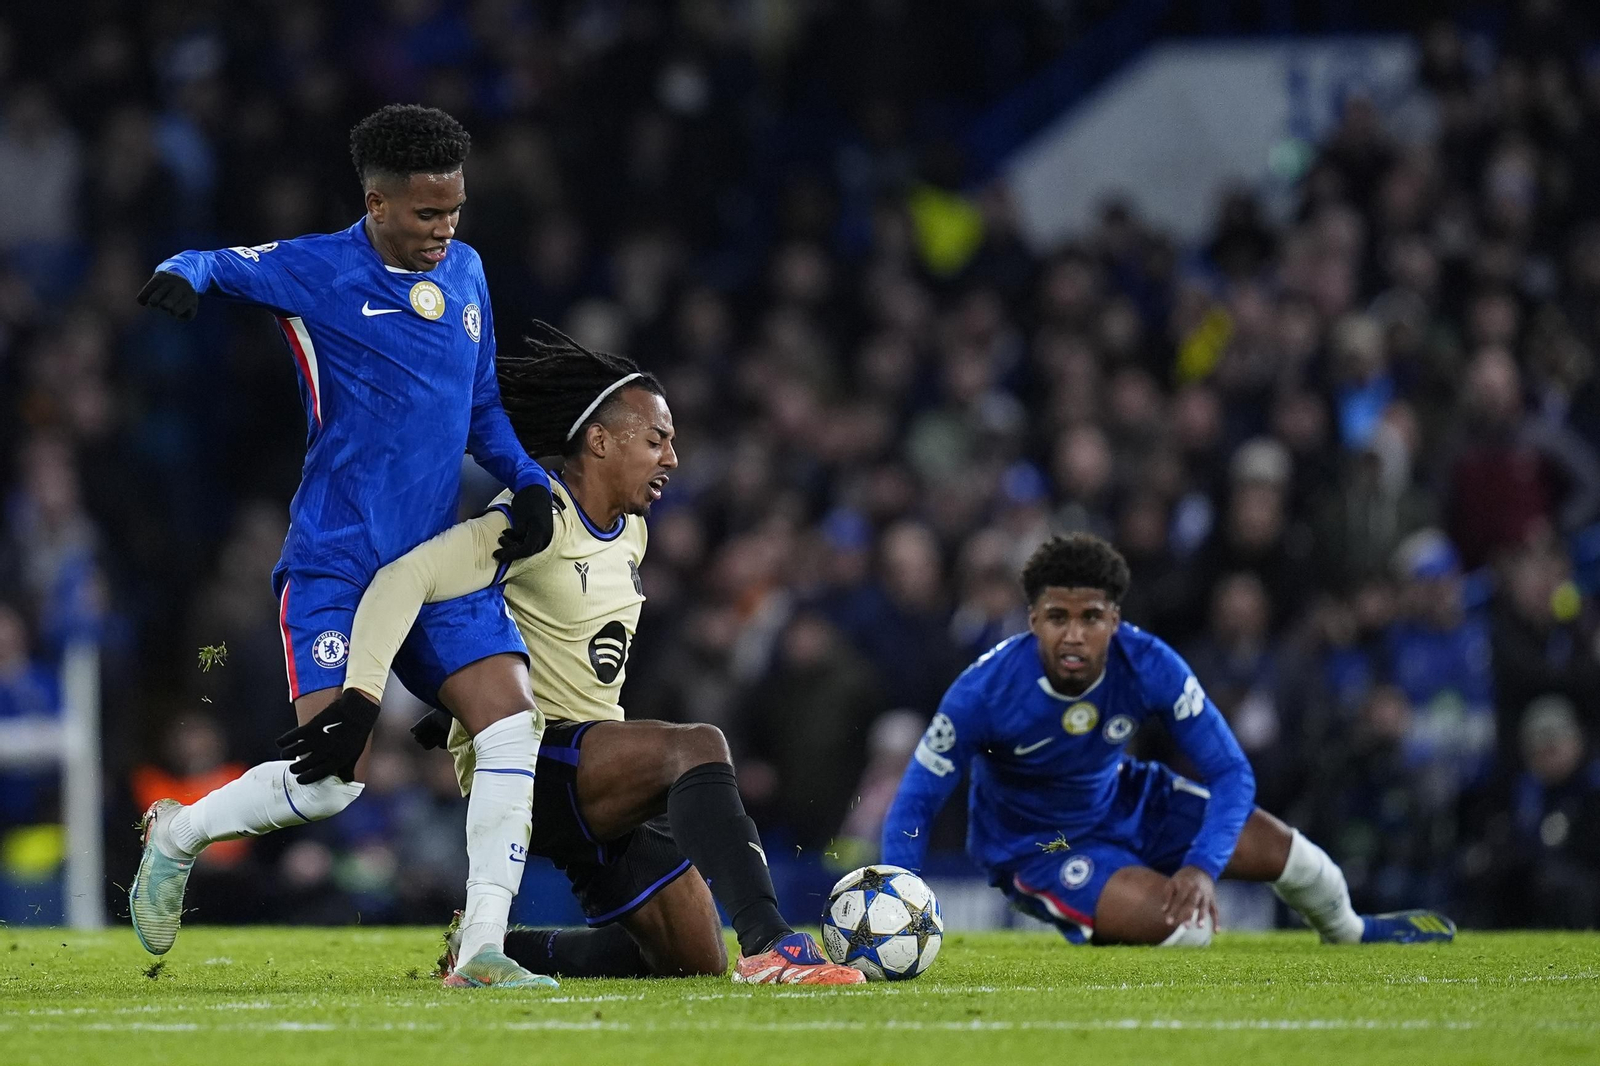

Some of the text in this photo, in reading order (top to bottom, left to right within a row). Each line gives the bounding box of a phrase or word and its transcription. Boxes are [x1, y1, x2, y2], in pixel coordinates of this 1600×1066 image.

[412, 284, 442, 306] WORLD CHAMPIONS
[317, 632, 342, 642] CHELSEA
